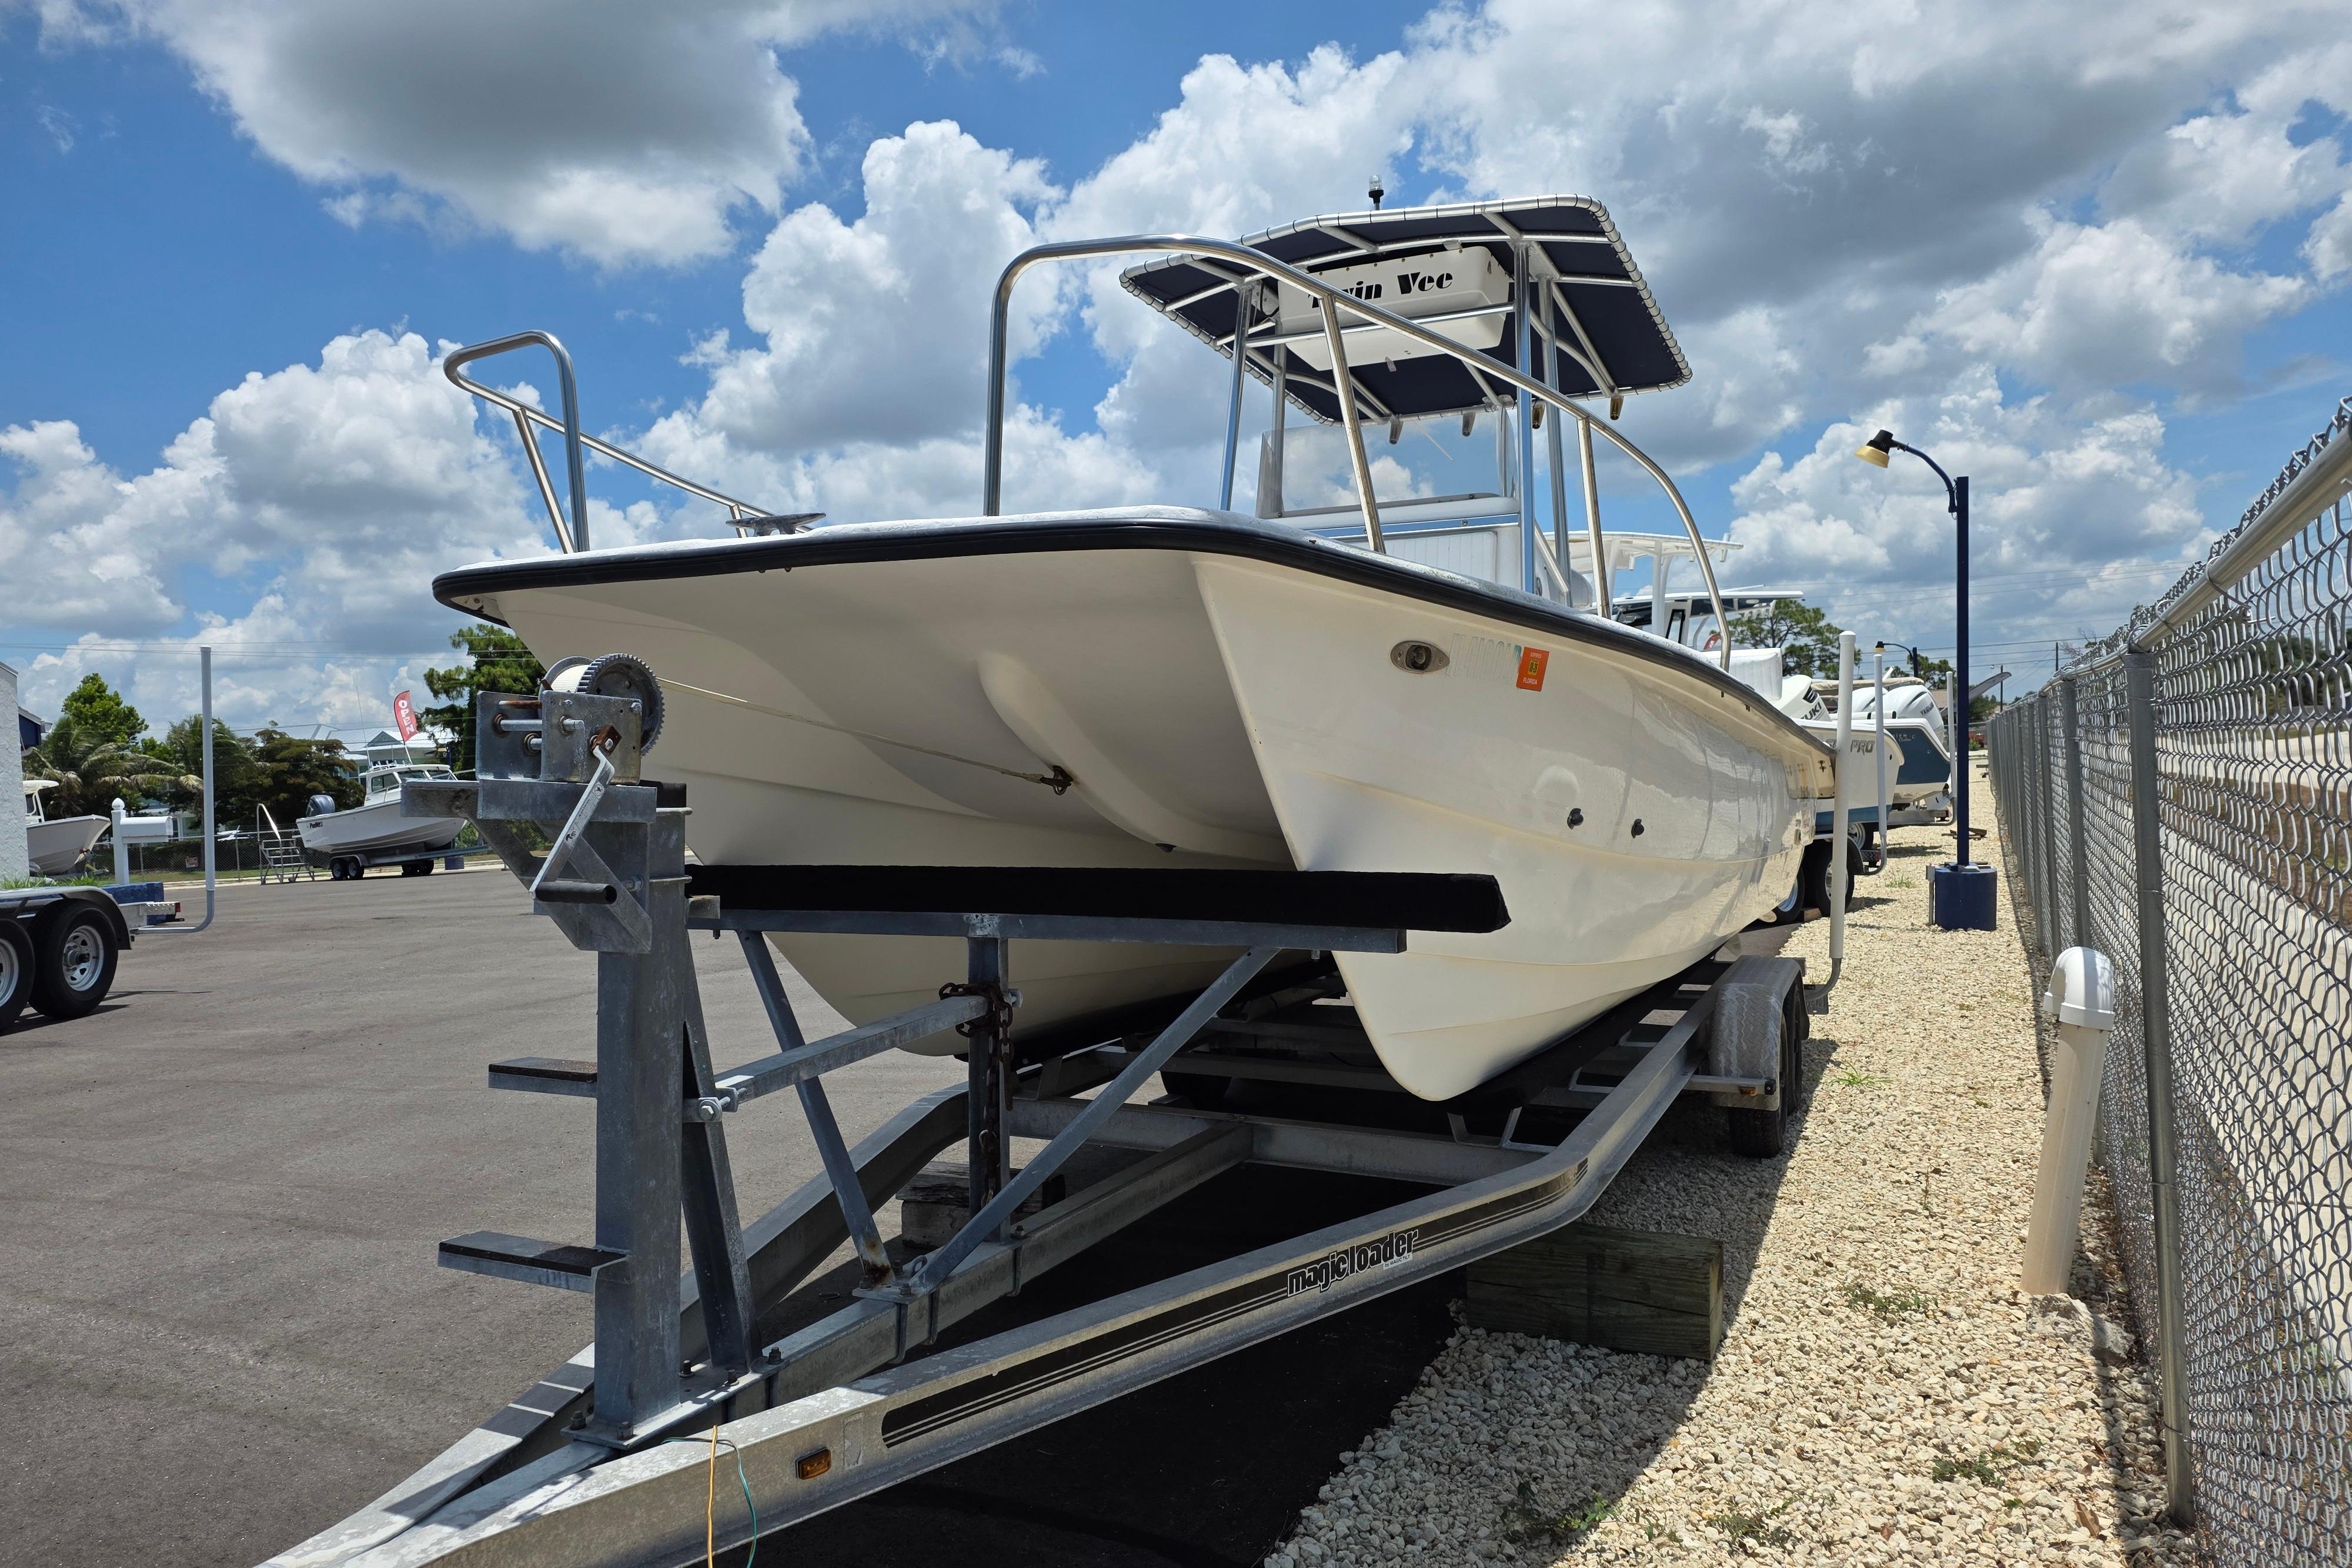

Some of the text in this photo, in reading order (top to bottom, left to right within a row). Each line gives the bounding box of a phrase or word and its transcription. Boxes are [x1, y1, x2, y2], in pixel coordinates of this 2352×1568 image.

[1397, 272, 1453, 295] Vee
[1523, 677, 1538, 685] FLORIDA
[398, 700, 415, 735] OPEN
[1800, 701, 1822, 720] UKI
[1850, 740, 1875, 755] PRO
[1390, 1257, 1402, 1265] MAGIC
